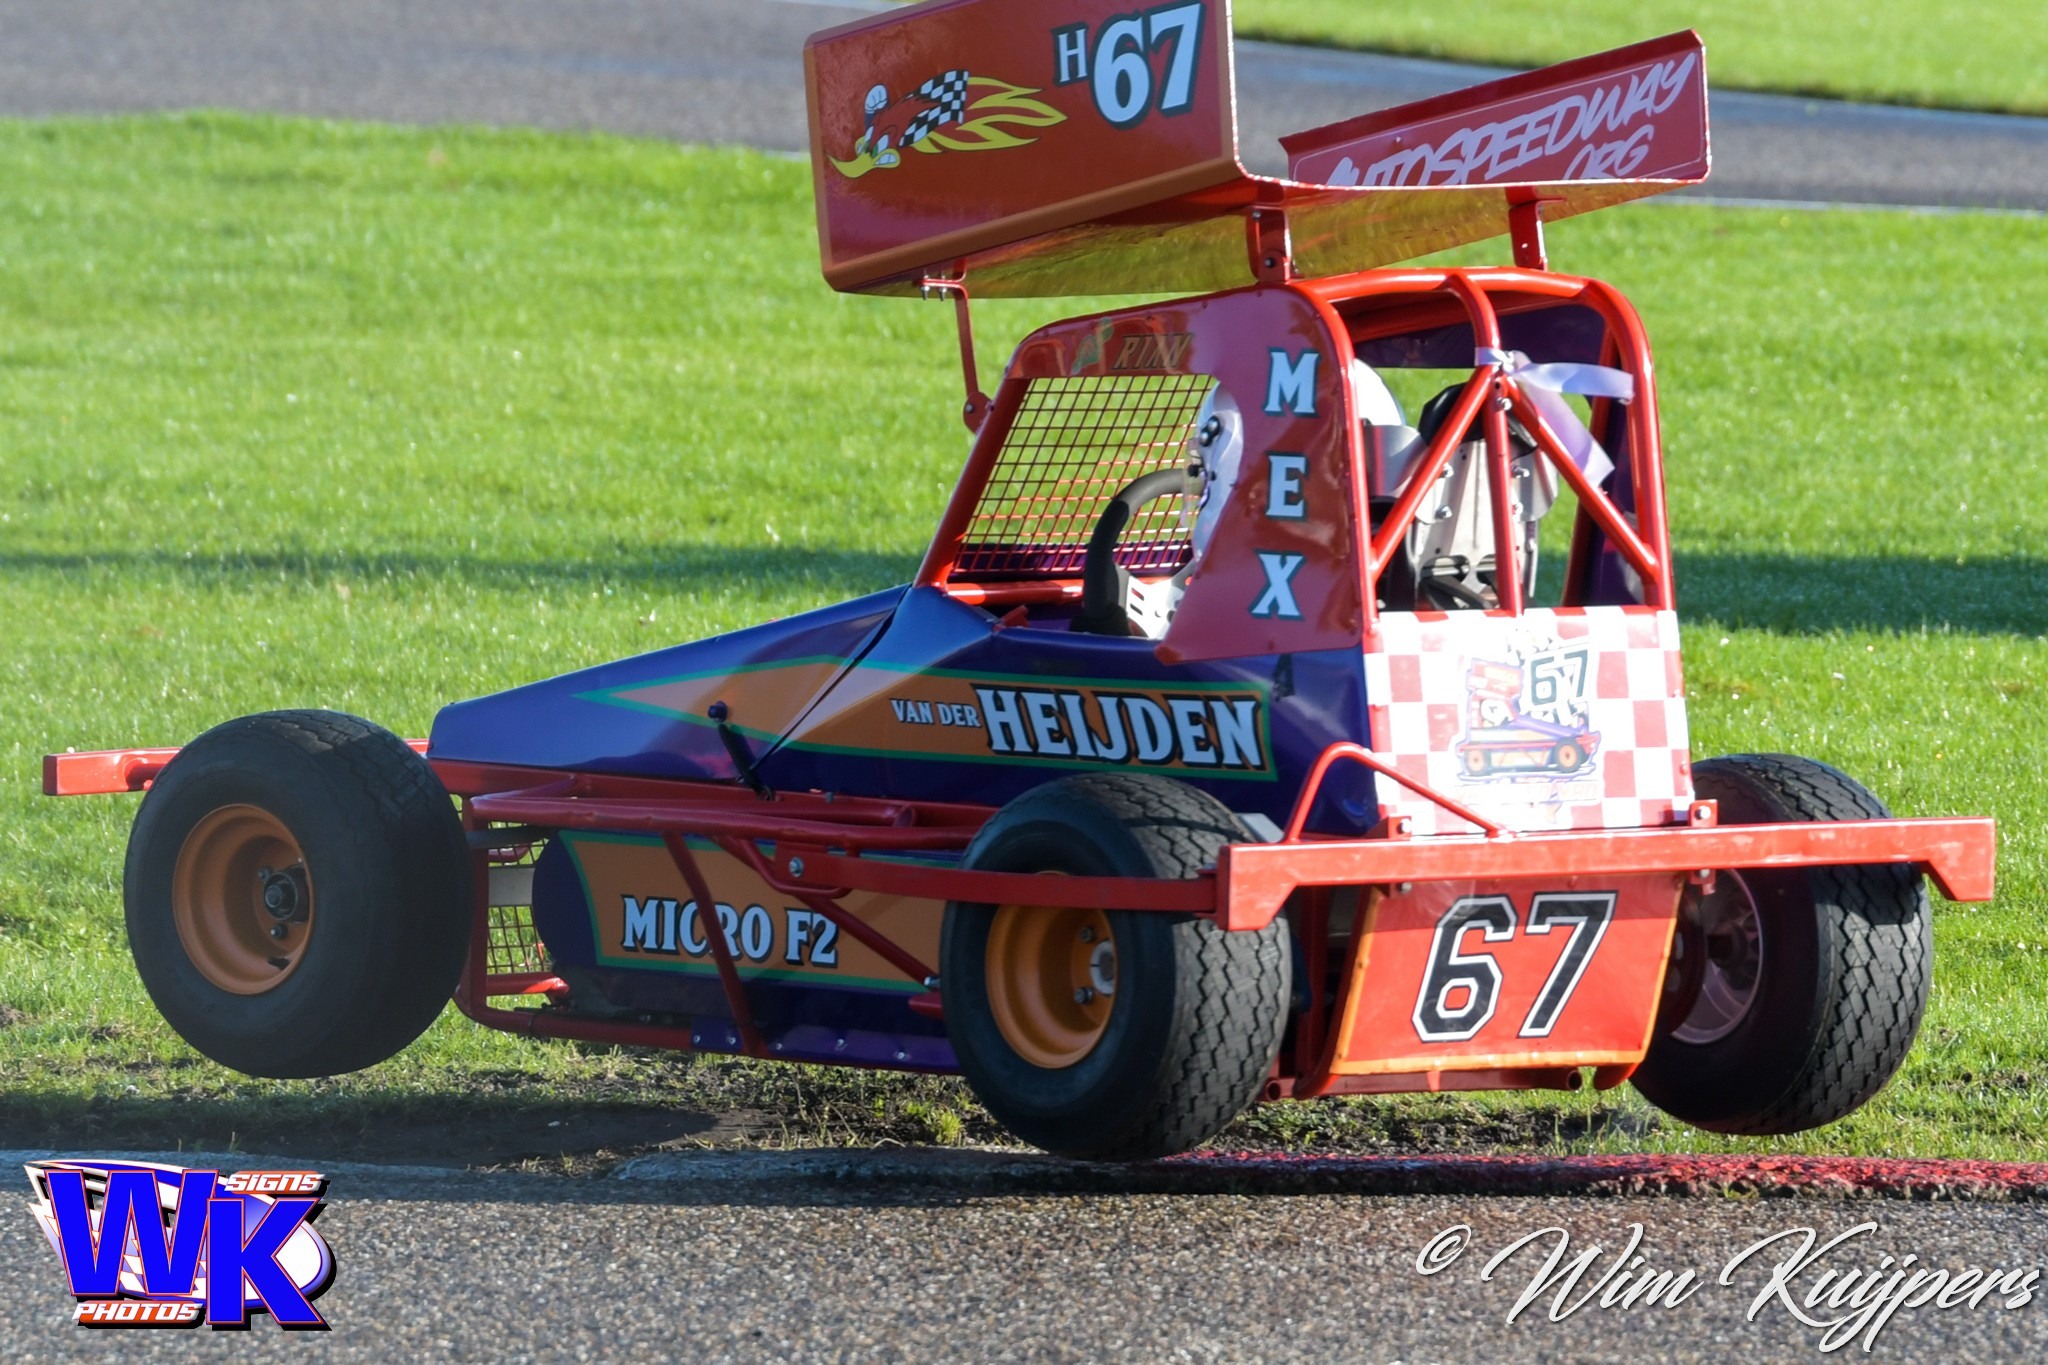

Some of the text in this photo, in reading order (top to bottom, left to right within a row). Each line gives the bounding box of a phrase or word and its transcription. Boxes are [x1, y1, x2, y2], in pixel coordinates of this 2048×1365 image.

[1563, 124, 1655, 180] ORG
[1530, 649, 1589, 706] 67
[890, 684, 1266, 771] VAN DER HEIJDEN
[621, 894, 838, 968] MICRO F2
[1412, 890, 1618, 1043] 67
